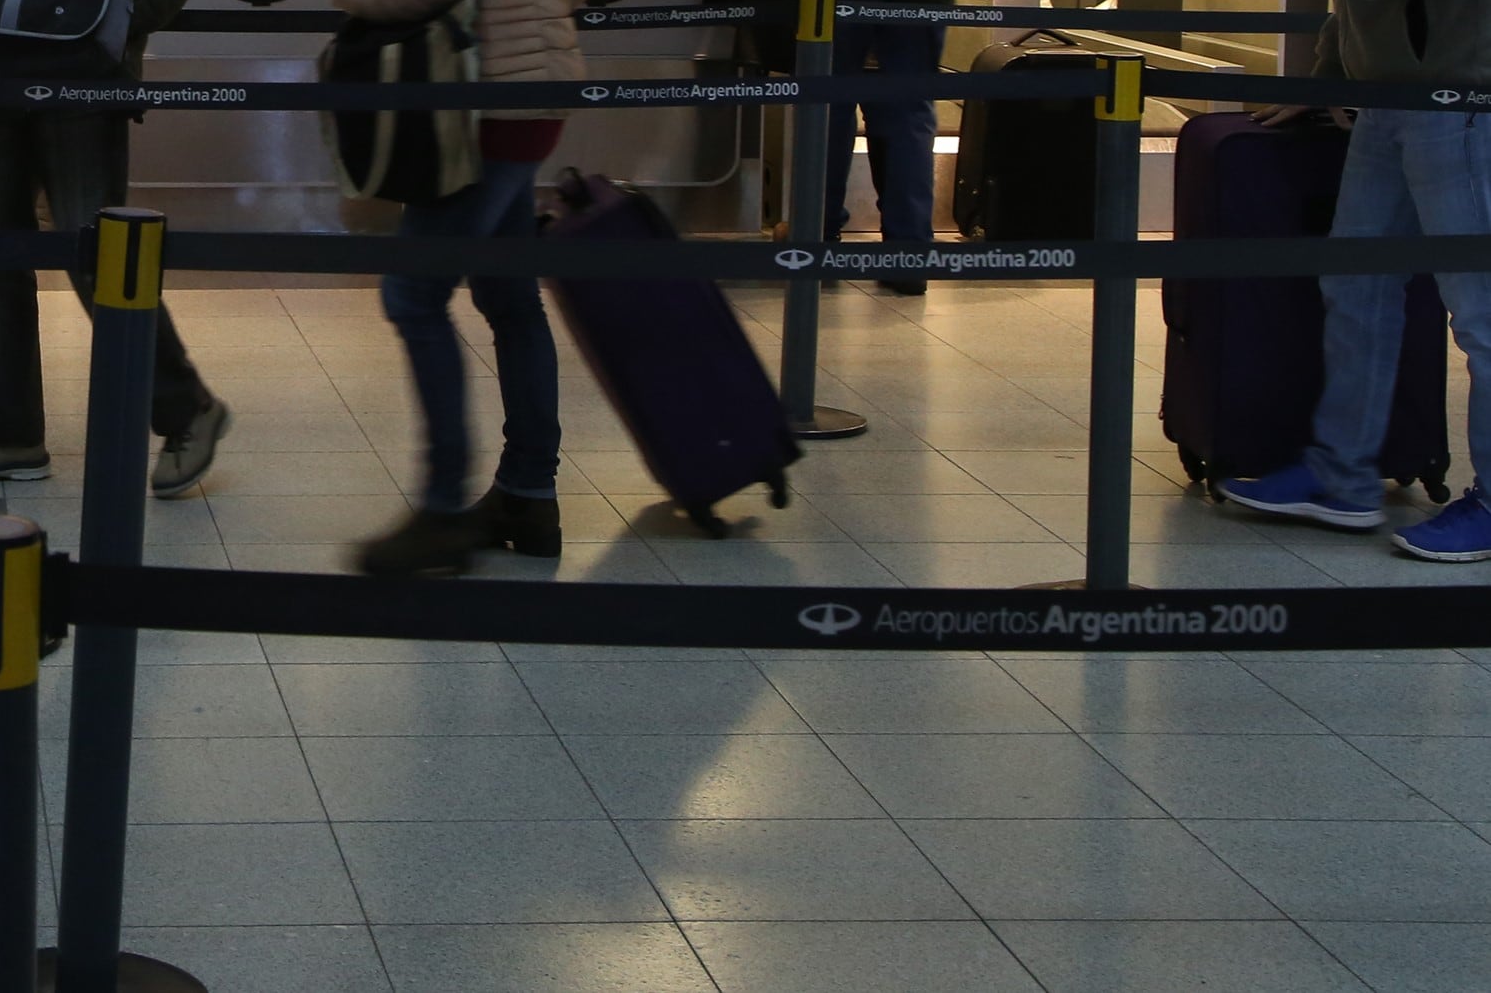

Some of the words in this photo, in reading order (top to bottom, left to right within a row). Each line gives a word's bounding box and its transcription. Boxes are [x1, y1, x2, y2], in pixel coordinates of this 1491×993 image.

[610, 11, 669, 24] Aeropuertos
[670, 9, 727, 22] Argentina
[728, 6, 755, 19] 2000
[859, 6, 917, 19] Aeropuertos
[918, 8, 975, 22] Argentina
[976, 10, 1003, 22] 2000
[59, 86, 134, 102] Aeropuertos
[135, 87, 210, 104] Argentina
[211, 88, 246, 102] 2000
[615, 85, 689, 102] Aeropuertos
[690, 83, 762, 100] Argentina
[764, 82, 799, 96] 2000
[821, 249, 924, 272] Aeropuertos
[925, 248, 1026, 272] Argentina
[1028, 249, 1076, 268] 2000
[872, 605, 1039, 641] Aeropuertos
[1041, 604, 1207, 642] Argentina
[1209, 605, 1288, 635] 2000
